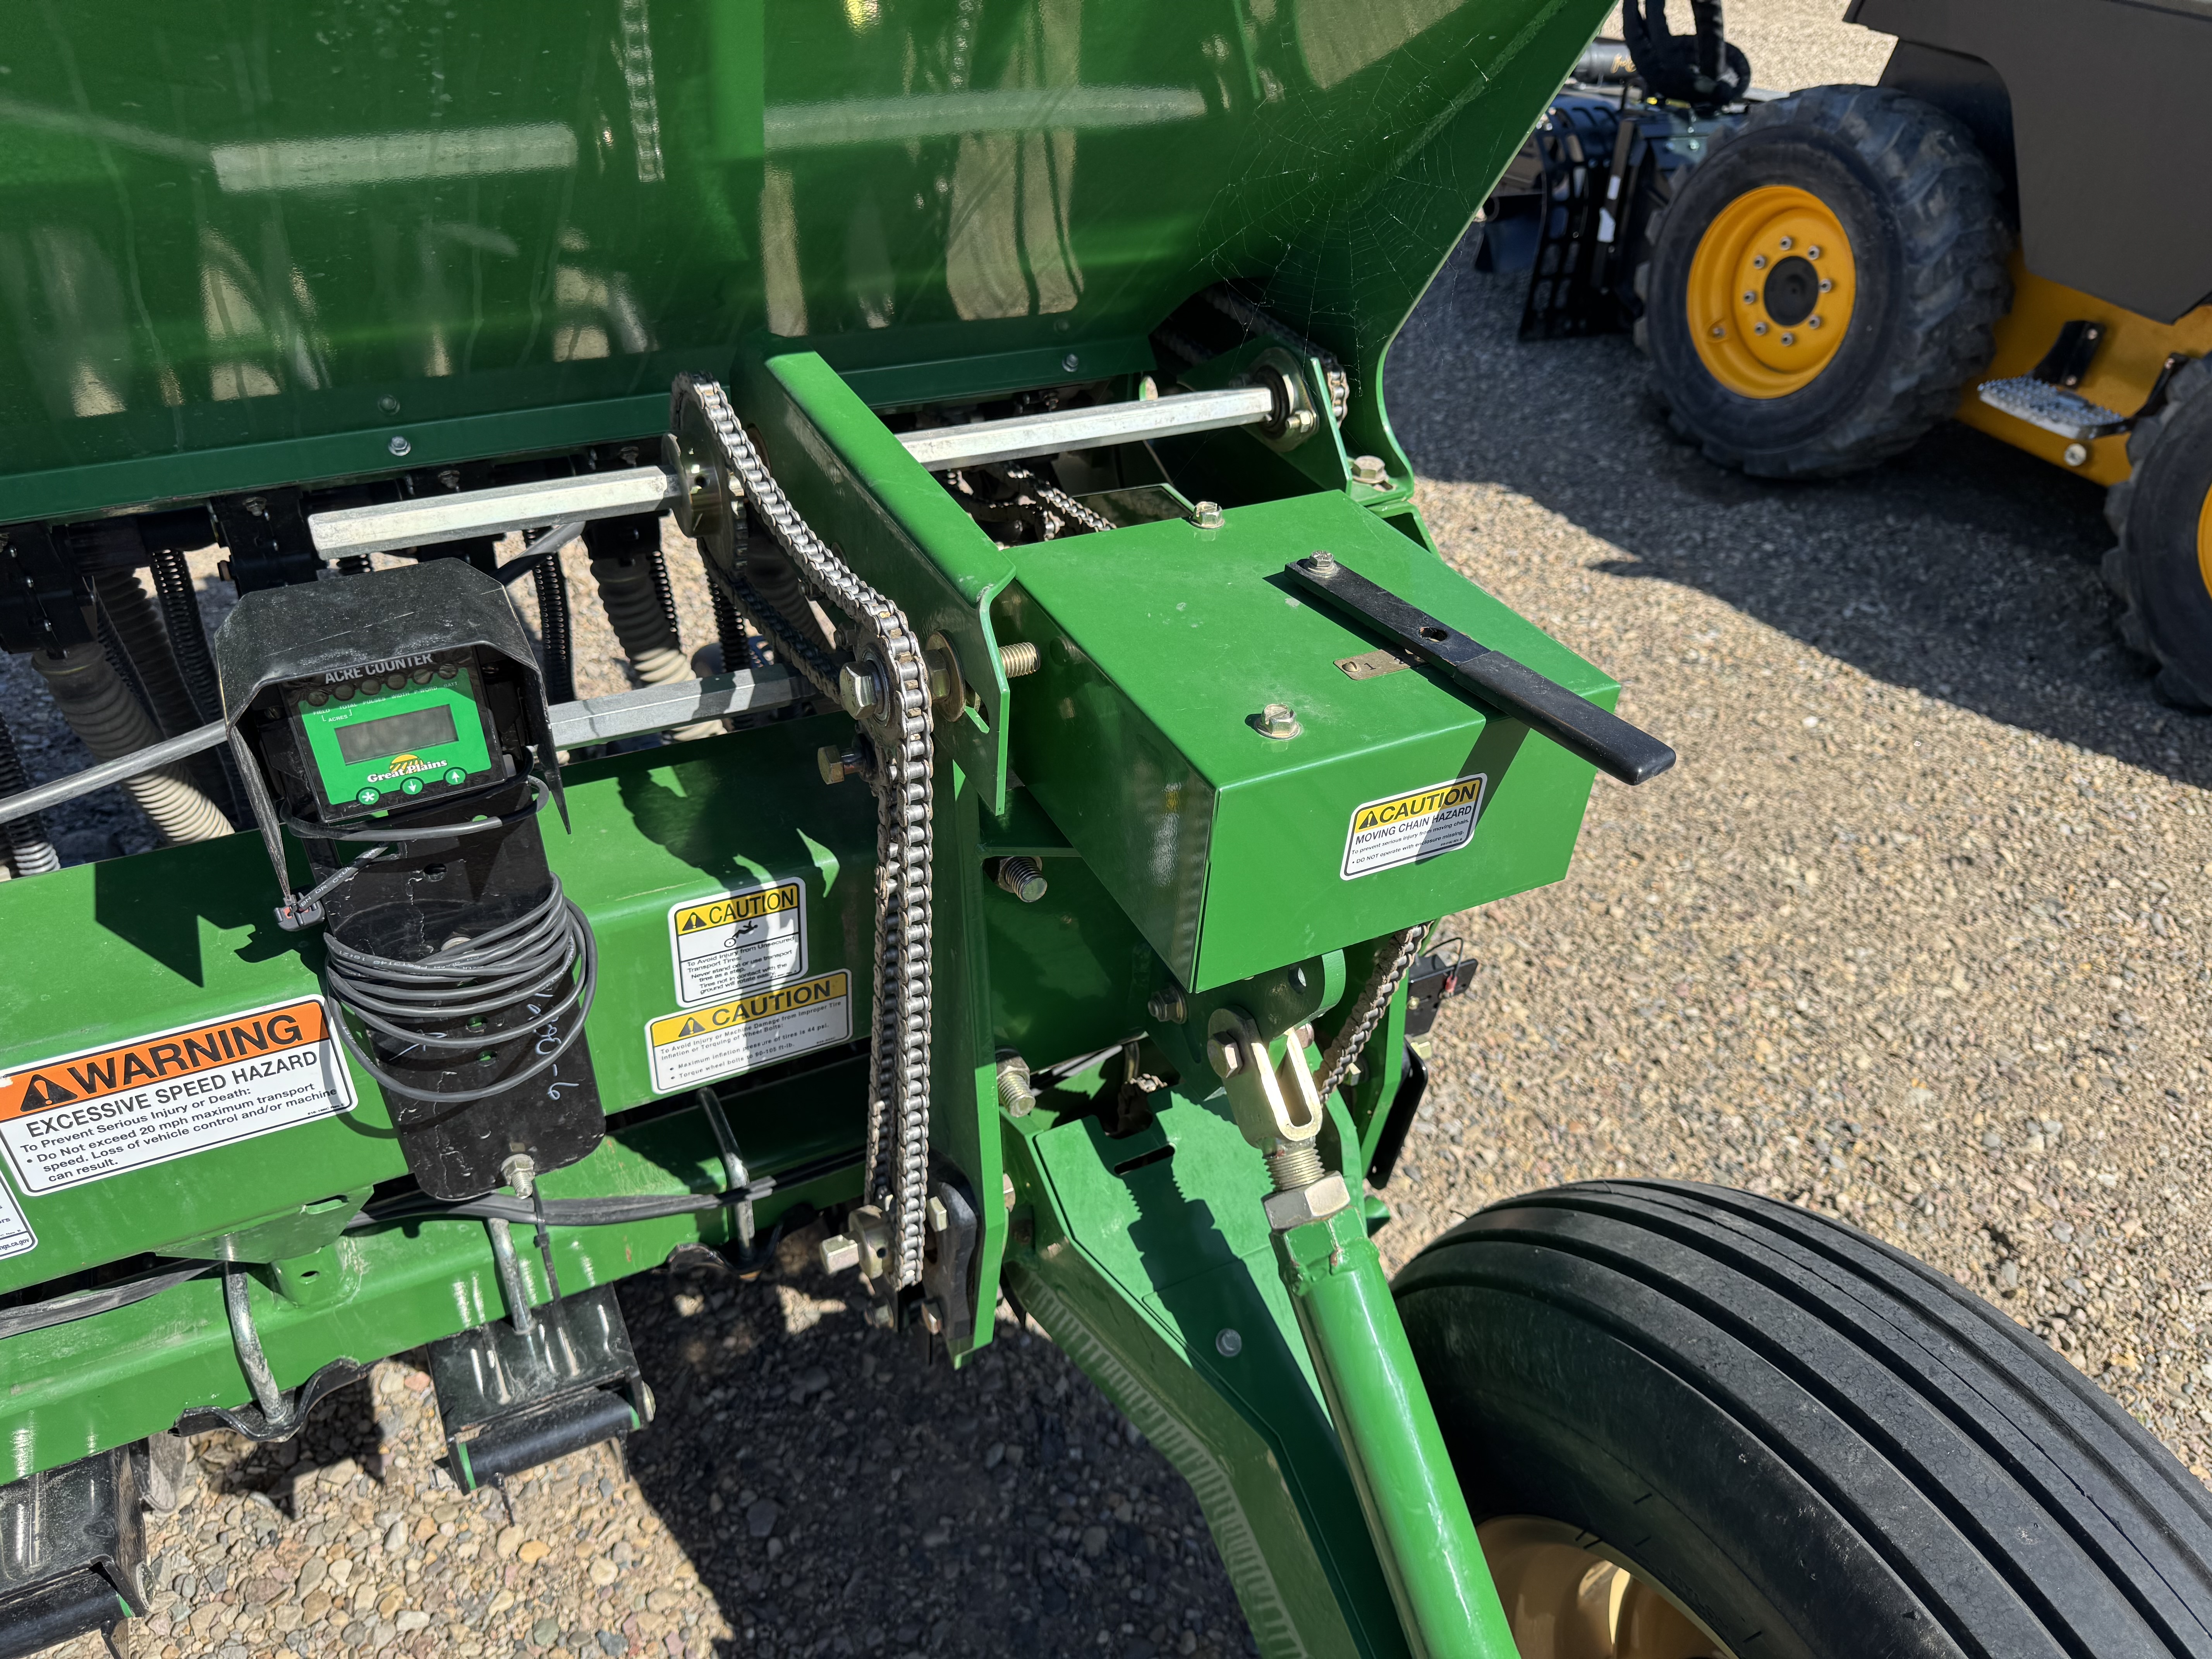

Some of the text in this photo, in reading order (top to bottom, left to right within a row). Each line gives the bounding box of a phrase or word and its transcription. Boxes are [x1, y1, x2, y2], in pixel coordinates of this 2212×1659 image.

[325, 654, 433, 684] ACRE COUNTER
[414, 686, 438, 694] P-WORD
[367, 760, 447, 783] Great Plains
[1379, 783, 1476, 823] CAUTION
[1355, 805, 1472, 845] MOVING CHAIN HAZARD
[1360, 843, 1381, 854] prevent
[1382, 838, 1402, 846] serious
[1433, 824, 1453, 832] moving
[1380, 848, 1401, 857] operate
[1415, 837, 1441, 847] enclosure
[1442, 831, 1464, 839] missing.
[709, 888, 794, 924] CAUTION
[691, 971, 711, 979] Never
[712, 965, 730, 974] stand
[763, 950, 792, 961] transport
[697, 955, 717, 965] Avoid
[719, 951, 738, 959] Injury
[757, 936, 794, 949] Unsecured
[687, 961, 721, 973] Transport
[737, 969, 761, 979] contact
[700, 984, 723, 995] ground
[737, 976, 756, 984] rotate
[712, 980, 830, 1026] CAUTION
[661, 1050, 689, 1060] Inflation
[701, 1038, 731, 1049] Torquing
[742, 1029, 762, 1038] Wheel
[764, 1024, 783, 1032] Bolts:
[672, 1042, 691, 1051] Avoid
[693, 1037, 713, 1045] Injury
[725, 1026, 752, 1037] Machine
[754, 1018, 780, 1029] Damage
[799, 1005, 827, 1016] Improper
[67, 1015, 303, 1094] WARNING
[678, 1057, 710, 1069] Maximum
[713, 1048, 740, 1059] inflation
[743, 1039, 772, 1052] pressure
[679, 1068, 703, 1078] Torque
[706, 1061, 725, 1071] wheel
[26, 1093, 151, 1138] EXCESSIVE
[155, 1075, 226, 1104] SPEED
[232, 1051, 317, 1084] HAZARD
[20, 1089, 251, 1153] To Prevent Serious Injury or Death:
[36, 1083, 315, 1162] Do Not exceed 20 mph maximum transport
[43, 1089, 337, 1172] speed. Loss of vehicle control and/or machine
[48, 1159, 118, 1182] can result.
